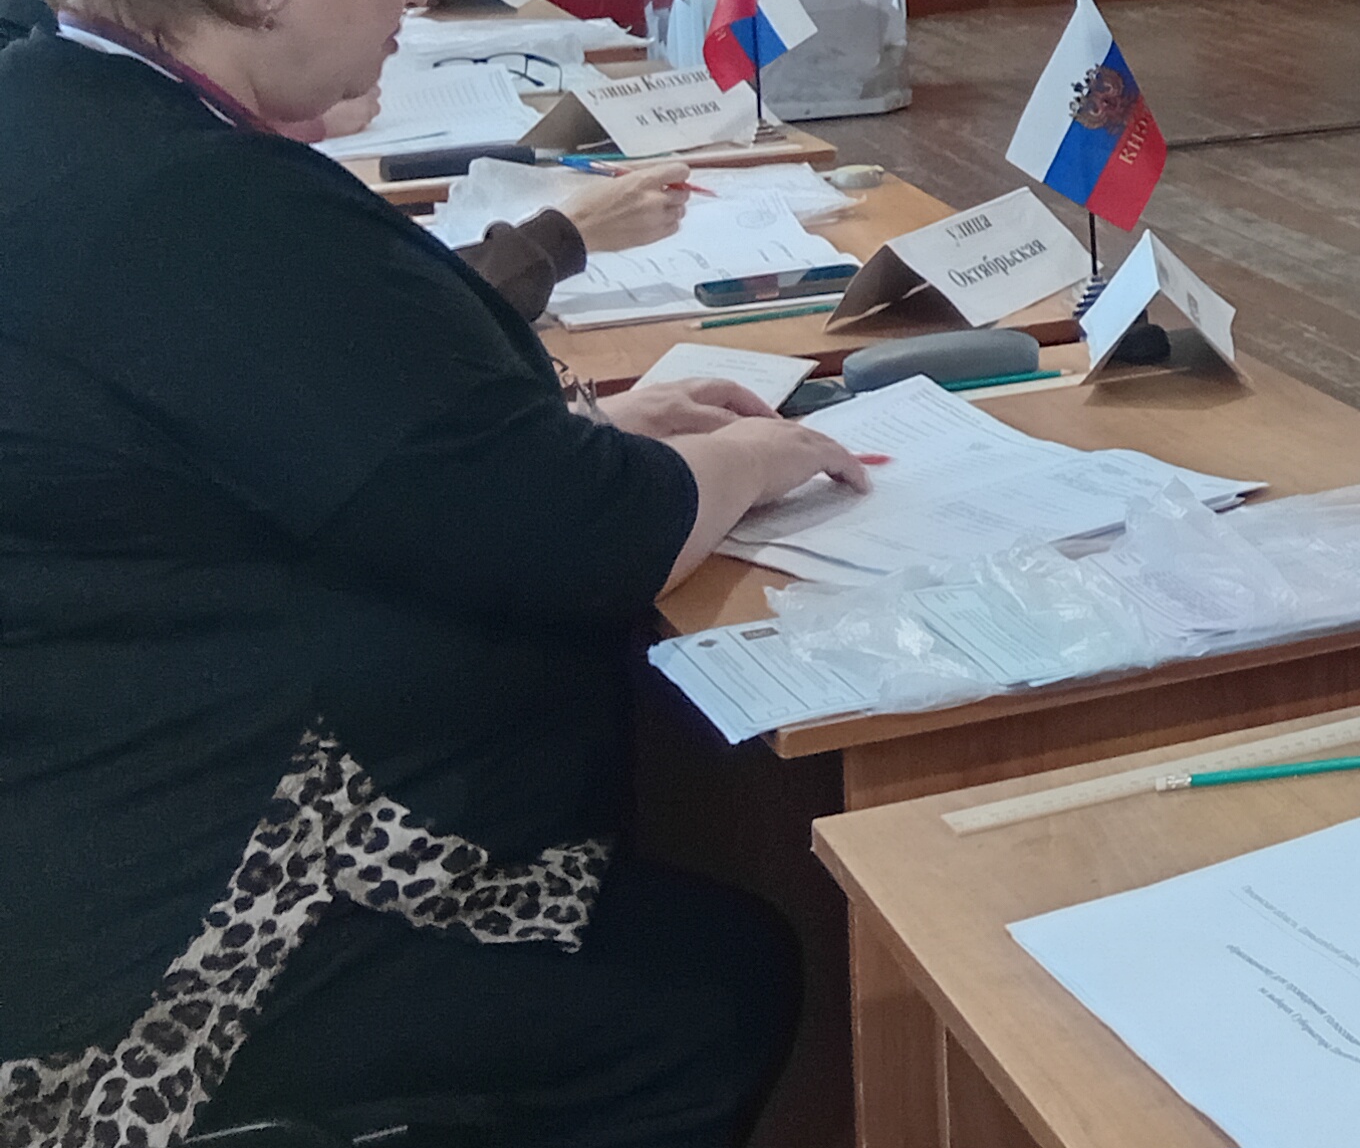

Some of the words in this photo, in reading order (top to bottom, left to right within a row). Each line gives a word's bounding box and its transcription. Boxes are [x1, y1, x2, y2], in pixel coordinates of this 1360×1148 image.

[587, 80, 642, 106] улицы
[635, 113, 650, 127] и
[651, 99, 722, 125] Красная
[945, 213, 993, 247] улица
[947, 238, 1048, 288] Октябрьская
